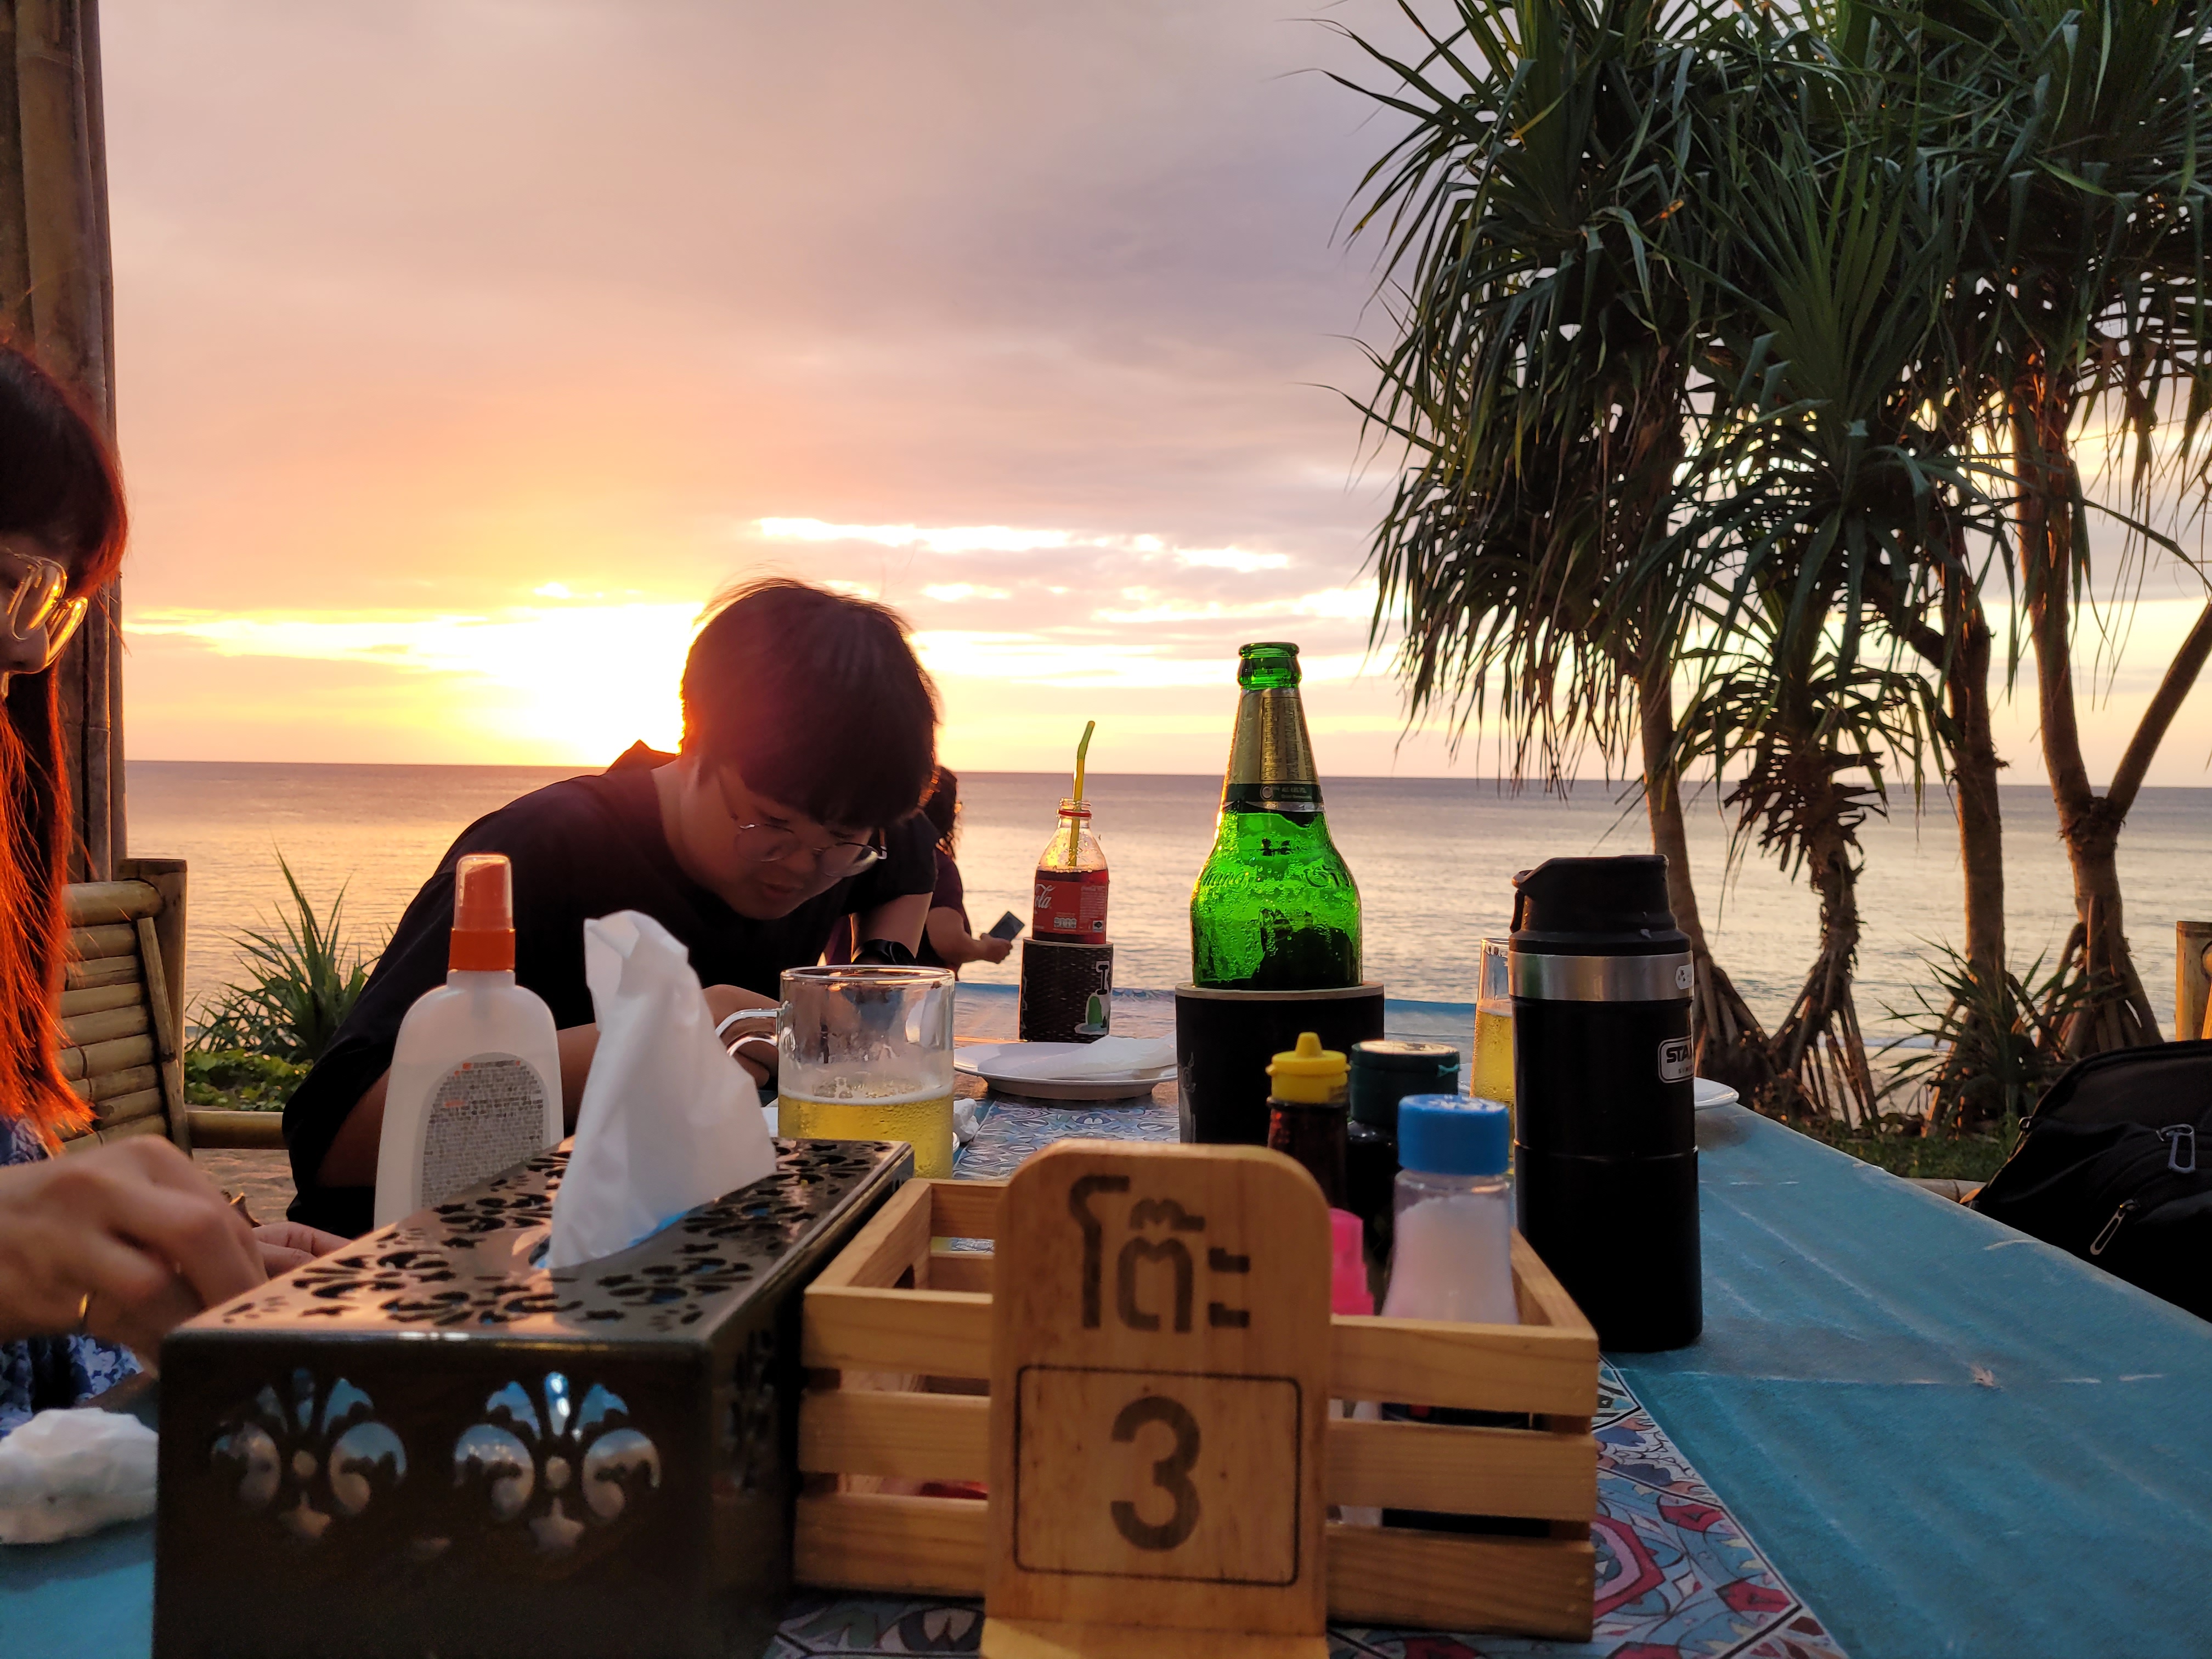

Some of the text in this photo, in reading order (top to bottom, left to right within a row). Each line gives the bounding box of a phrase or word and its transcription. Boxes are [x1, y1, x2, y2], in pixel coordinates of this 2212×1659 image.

[1666, 1045, 1692, 1064] STA
[1068, 1175, 1251, 1334] โต๊ะ
[1110, 1395, 1201, 1552] 3
